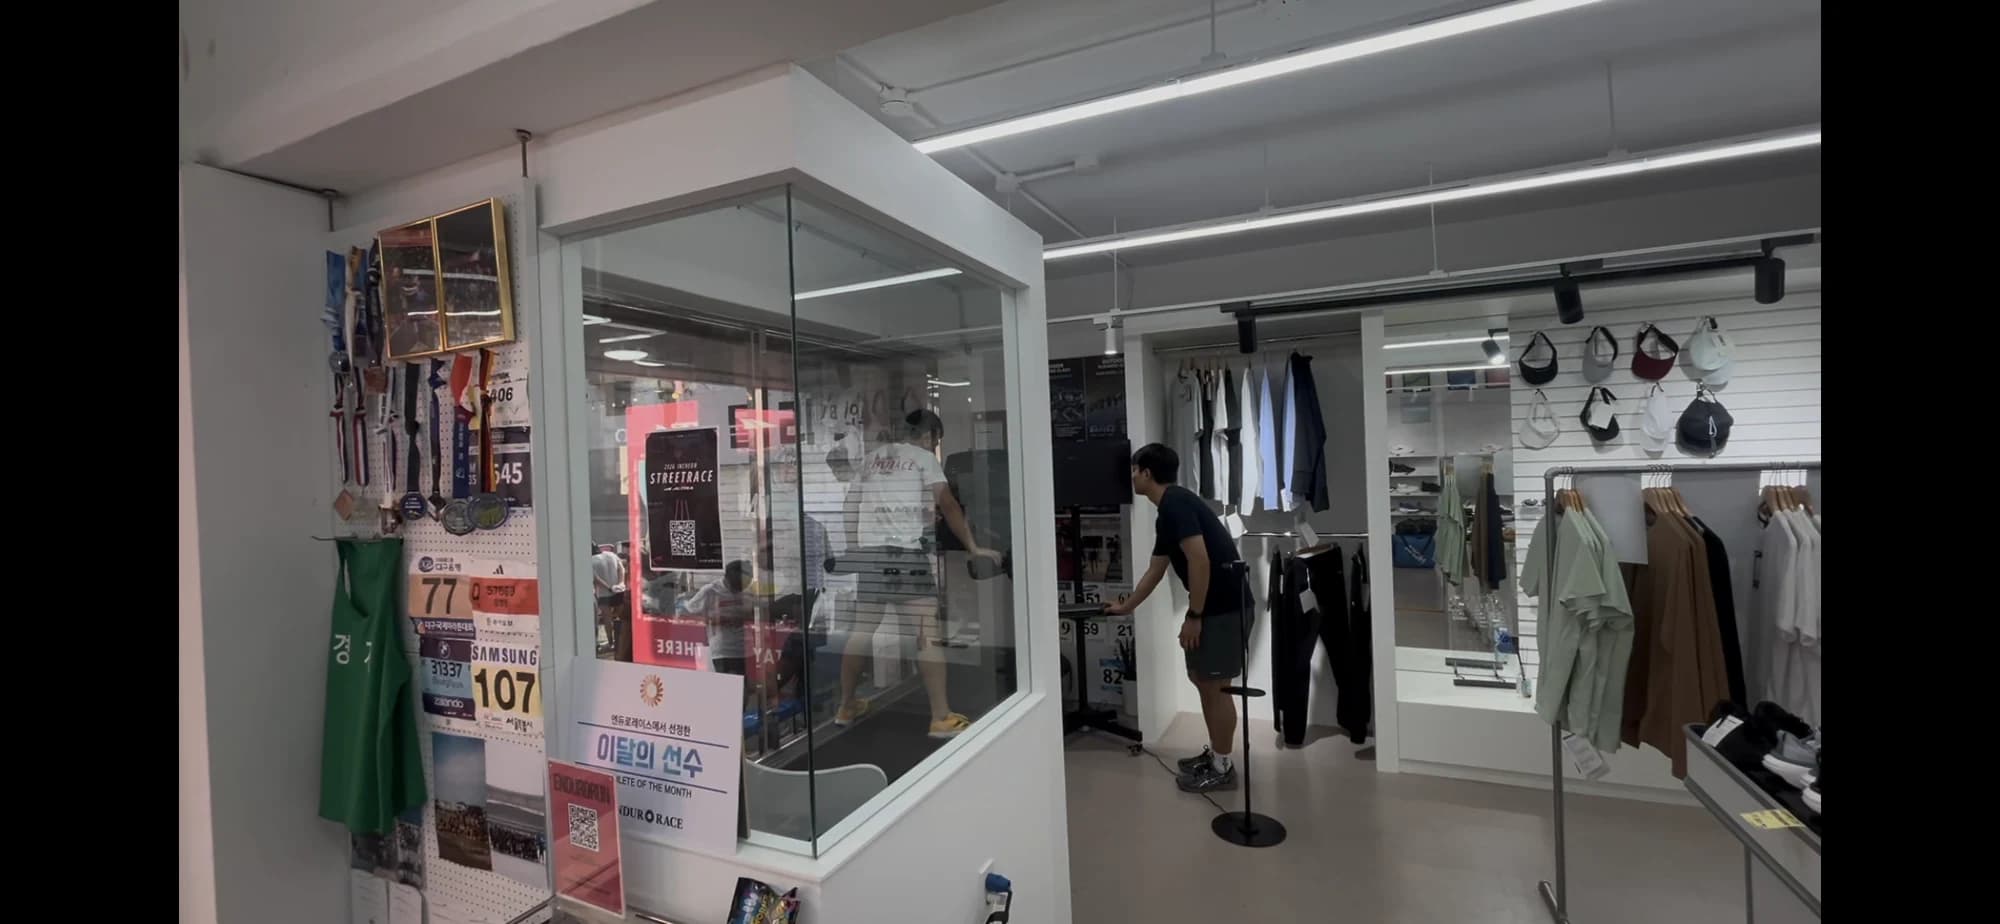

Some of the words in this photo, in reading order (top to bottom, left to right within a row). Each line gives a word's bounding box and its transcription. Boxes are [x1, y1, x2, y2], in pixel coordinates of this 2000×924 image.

[650, 470, 713, 485] STREETRACE
[422, 578, 457, 615] 77
[1117, 624, 1133, 637] 21
[471, 645, 537, 666] SAMSUNG
[431, 660, 462, 678] 31337
[474, 668, 535, 714] 107
[611, 714, 667, 733] 엔듀로레이스에서
[668, 722, 691, 737] 선정한
[597, 733, 654, 769] 이달의
[662, 744, 703, 778] 선수
[637, 779, 647, 789] OF
[648, 781, 663, 793] THE
[664, 784, 692, 799] MONTH
